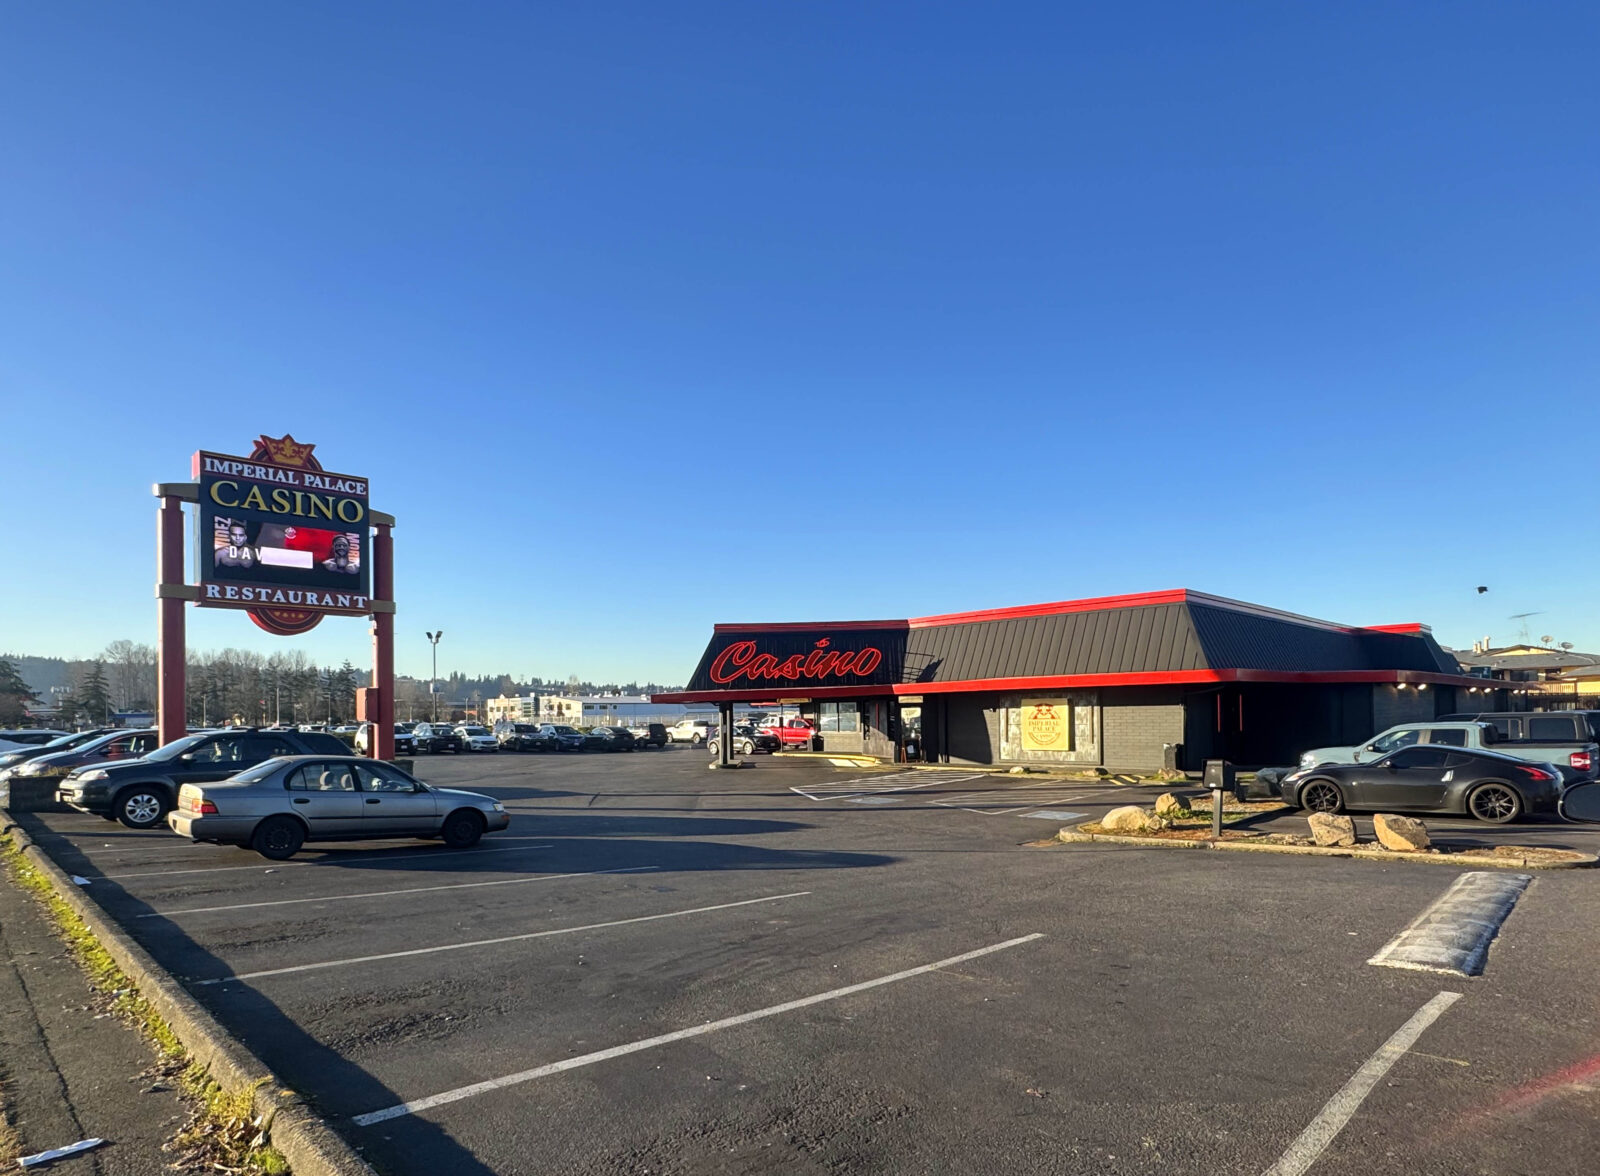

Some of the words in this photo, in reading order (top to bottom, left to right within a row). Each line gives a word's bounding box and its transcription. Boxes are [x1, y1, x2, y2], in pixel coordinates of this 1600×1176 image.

[204, 457, 299, 485] IMPERIAL
[304, 473, 367, 495] PALACE
[209, 480, 364, 523] CASINO
[206, 584, 367, 608] RESTAURANT
[709, 637, 882, 684] Casino
